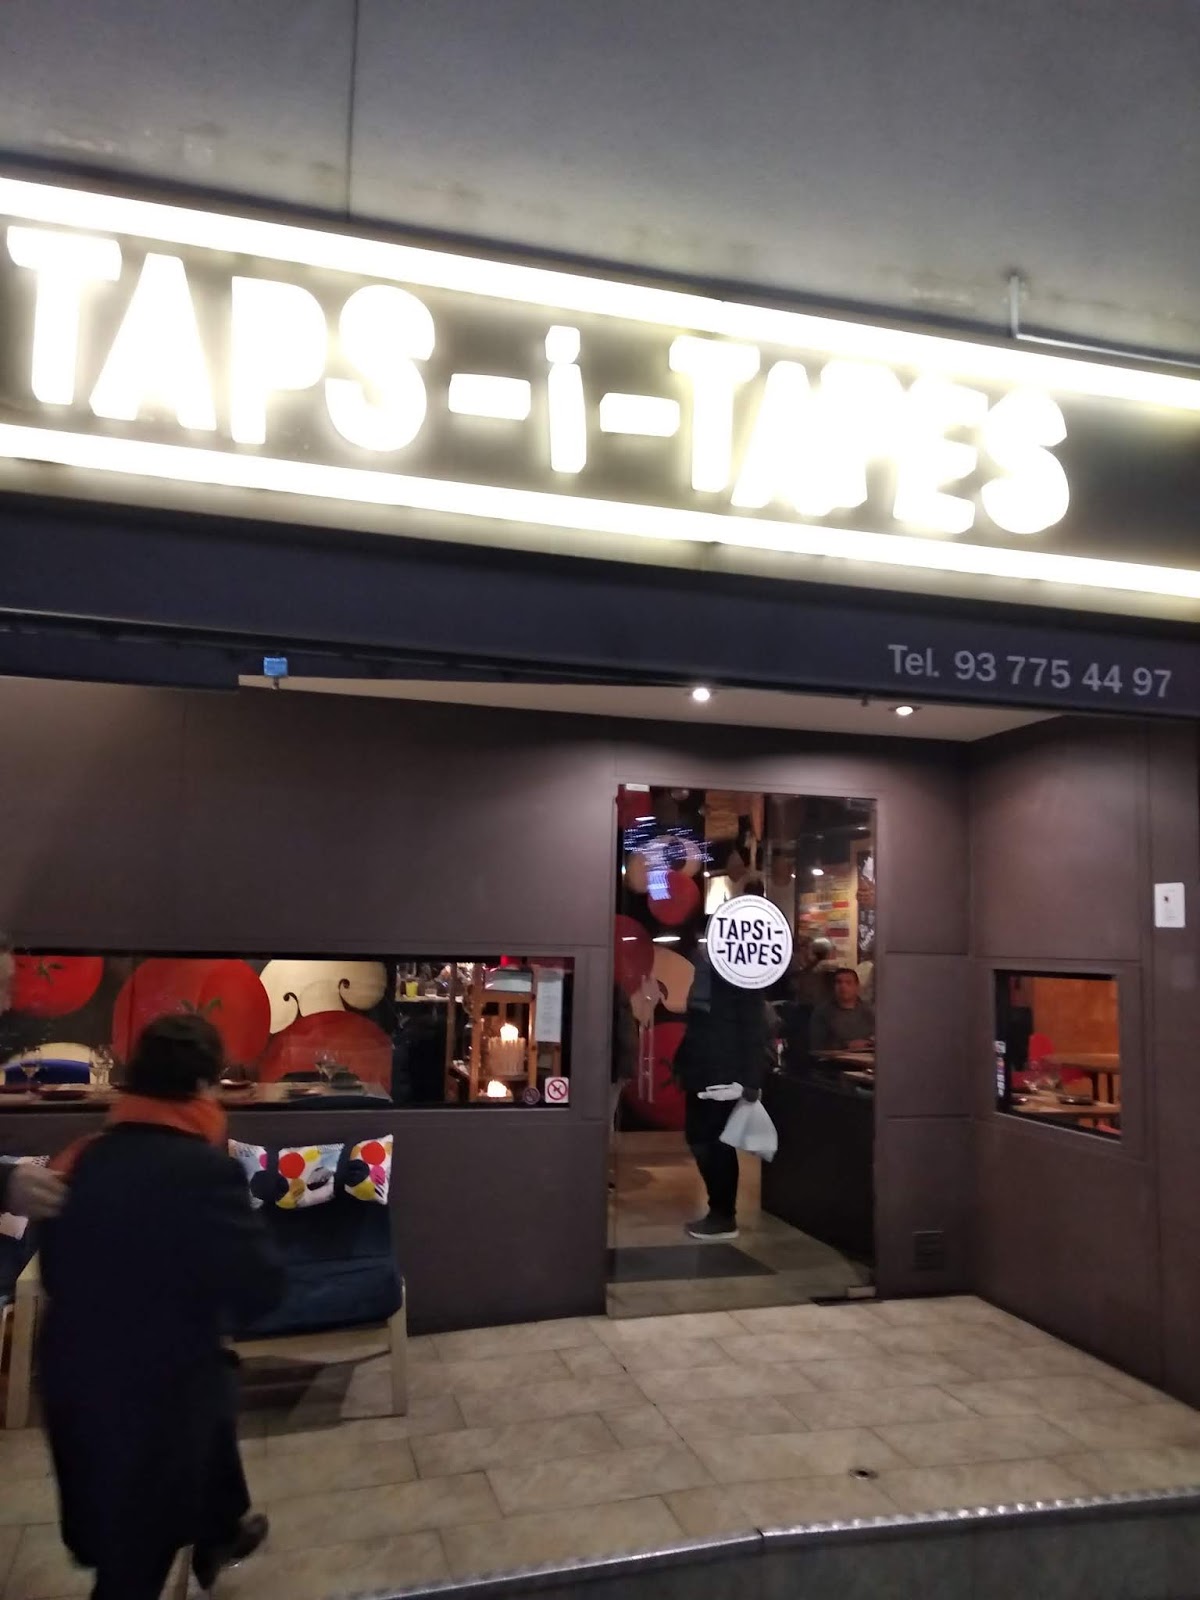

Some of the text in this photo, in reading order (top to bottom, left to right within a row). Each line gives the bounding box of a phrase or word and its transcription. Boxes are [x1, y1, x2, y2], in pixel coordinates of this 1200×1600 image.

[888, 644, 1172, 698] Tel. 93 775 44 97
